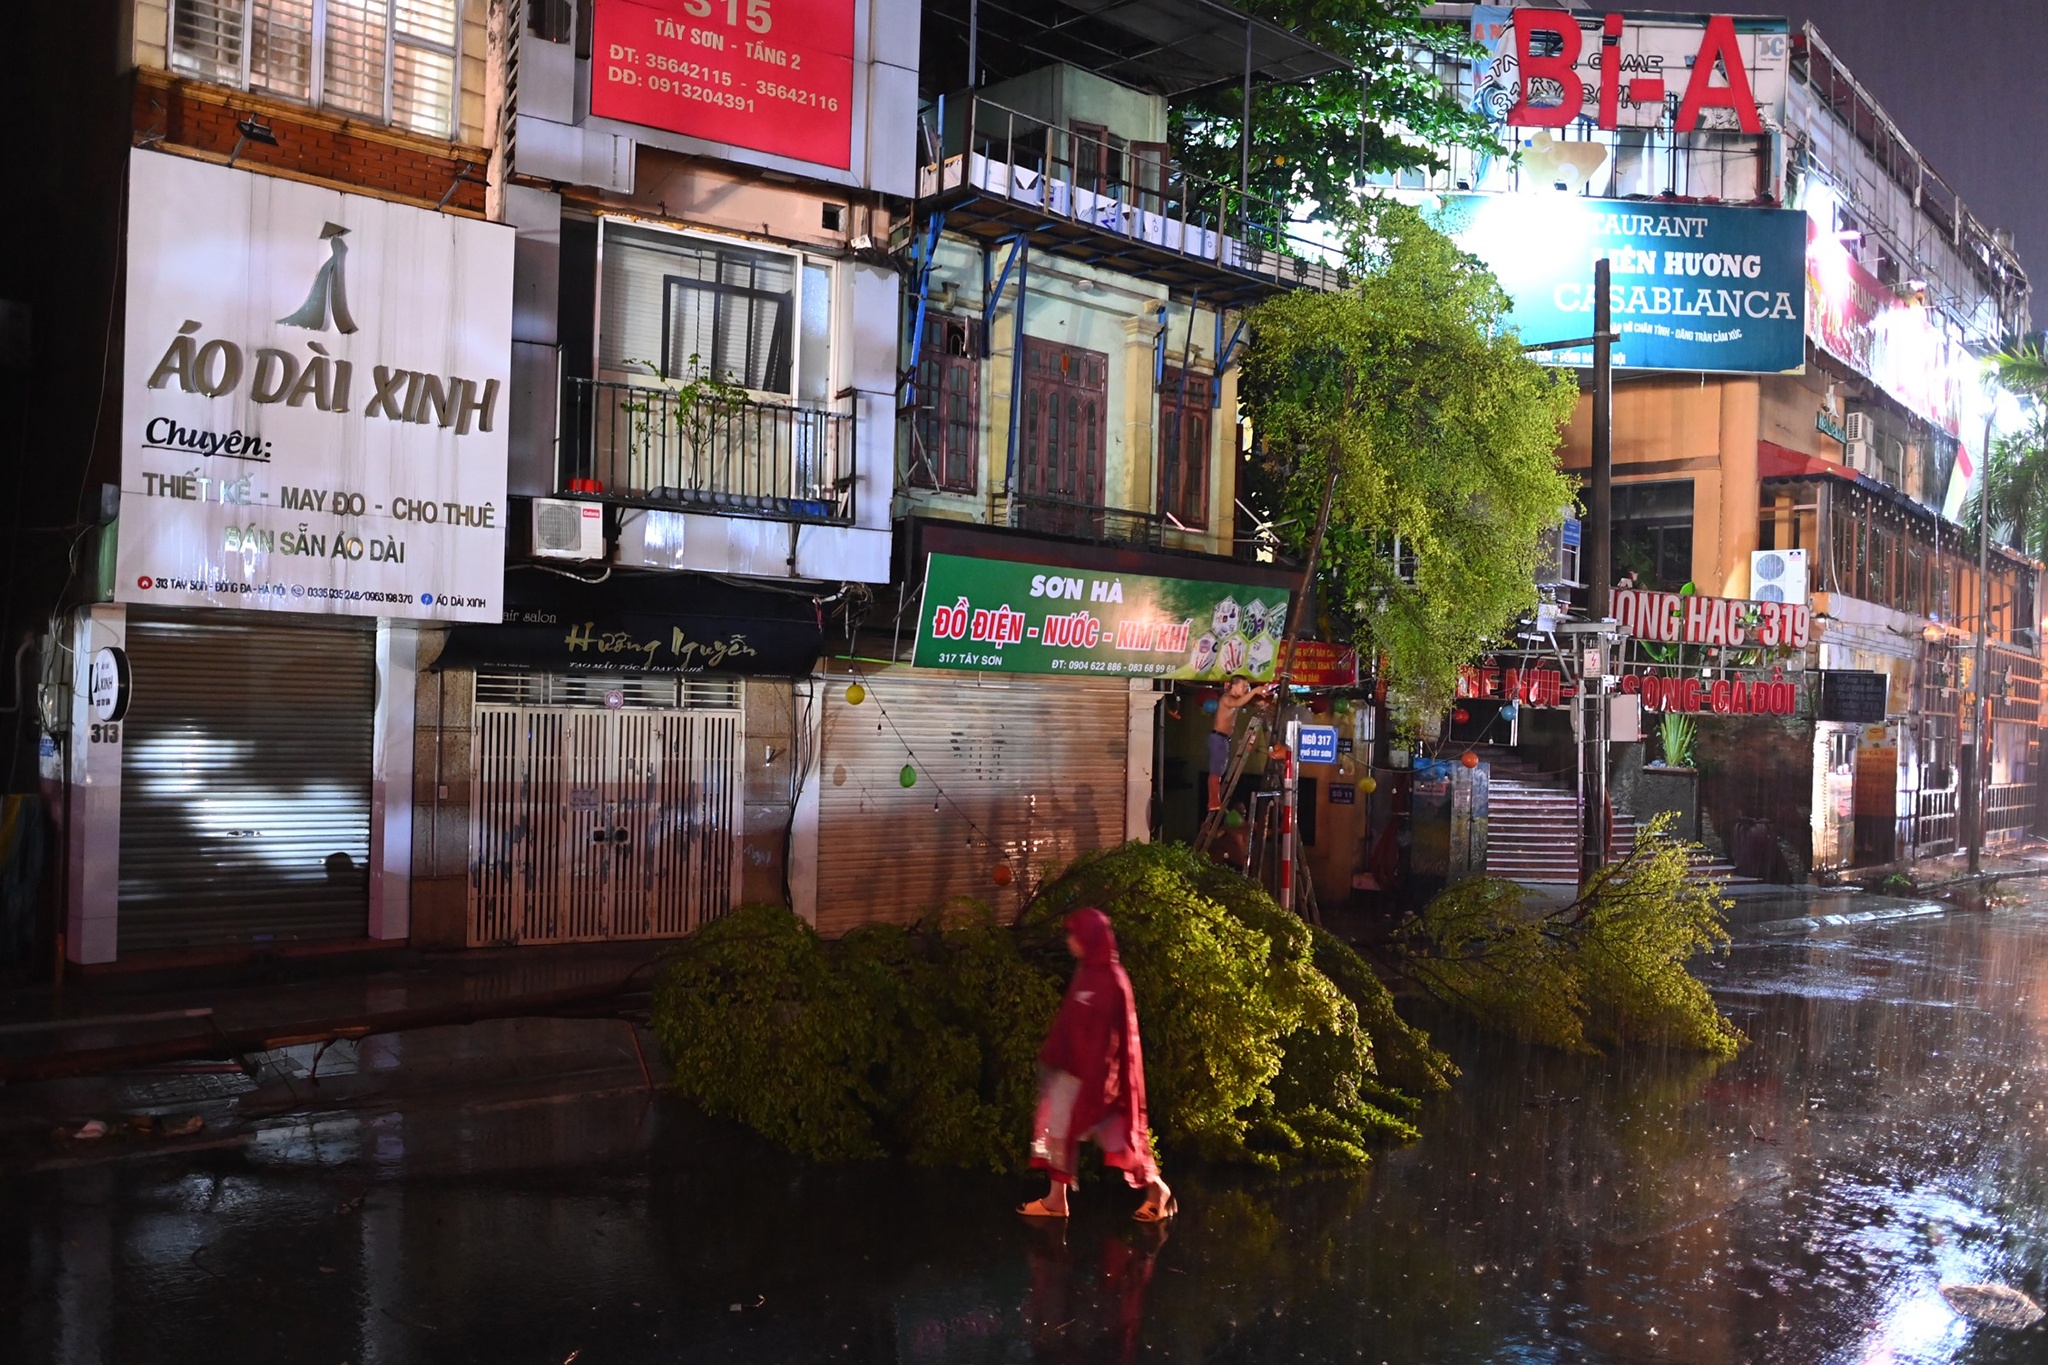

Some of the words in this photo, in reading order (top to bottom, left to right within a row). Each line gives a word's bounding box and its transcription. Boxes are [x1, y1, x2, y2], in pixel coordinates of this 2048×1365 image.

[654, 18, 686, 41] TÂY
[690, 27, 724, 51] SƠN
[745, 40, 786, 67] TẦNG
[791, 54, 801, 70] 2
[608, 66, 642, 87] DĐ:
[648, 75, 754, 113] 0913204391
[609, 44, 639, 64] ĐT:
[645, 53, 732, 87] 35642115
[756, 80, 838, 112] 35642116
[1664, 251, 1761, 279] HƯƠNG
[148, 319, 244, 398] ÁO
[250, 341, 353, 413] DÀI
[364, 365, 501, 436] XINH
[145, 416, 273, 459] Chuyên:
[142, 467, 212, 504] THIẾT
[218, 472, 254, 507] KẾ
[281, 486, 326, 512] MAY
[332, 491, 366, 517] ĐO
[392, 497, 438, 523] CHO
[443, 501, 495, 528] THUÊ
[224, 522, 275, 554] BÁN
[280, 523, 326, 557] SẴN
[331, 530, 364, 561] ÁO
[370, 535, 405, 563] DÀI
[155, 578, 168, 589] 313
[398, 594, 413, 604] 370
[1030, 574, 1085, 601] SƠN
[1090, 576, 1123, 603] HÀ
[523, 609, 557, 623] salon
[932, 595, 970, 640] ĐỒ
[970, 603, 1026, 650] ĐIỆN
[1042, 610, 1100, 647] NƯỚC
[1116, 620, 1156, 651] KIM
[1155, 618, 1194, 652] KHÍ
[1760, 601, 1810, 648] 319
[939, 653, 957, 664] 317
[959, 652, 979, 665] TÂY
[981, 655, 1002, 666] SƠN
[1051, 660, 1066, 669] ĐT:
[1069, 660, 1089, 670] 0904
[1090, 661, 1105, 671] 622
[1107, 662, 1121, 671] 886
[1128, 663, 1142, 672] 083
[1144, 664, 1154, 673] 68
[1155, 664, 1164, 673] 99
[1166, 665, 1176, 673] 68
[1751, 666, 1796, 715] ĐỒI
[91, 724, 119, 743] 313
[1317, 735, 1331, 746] 317
